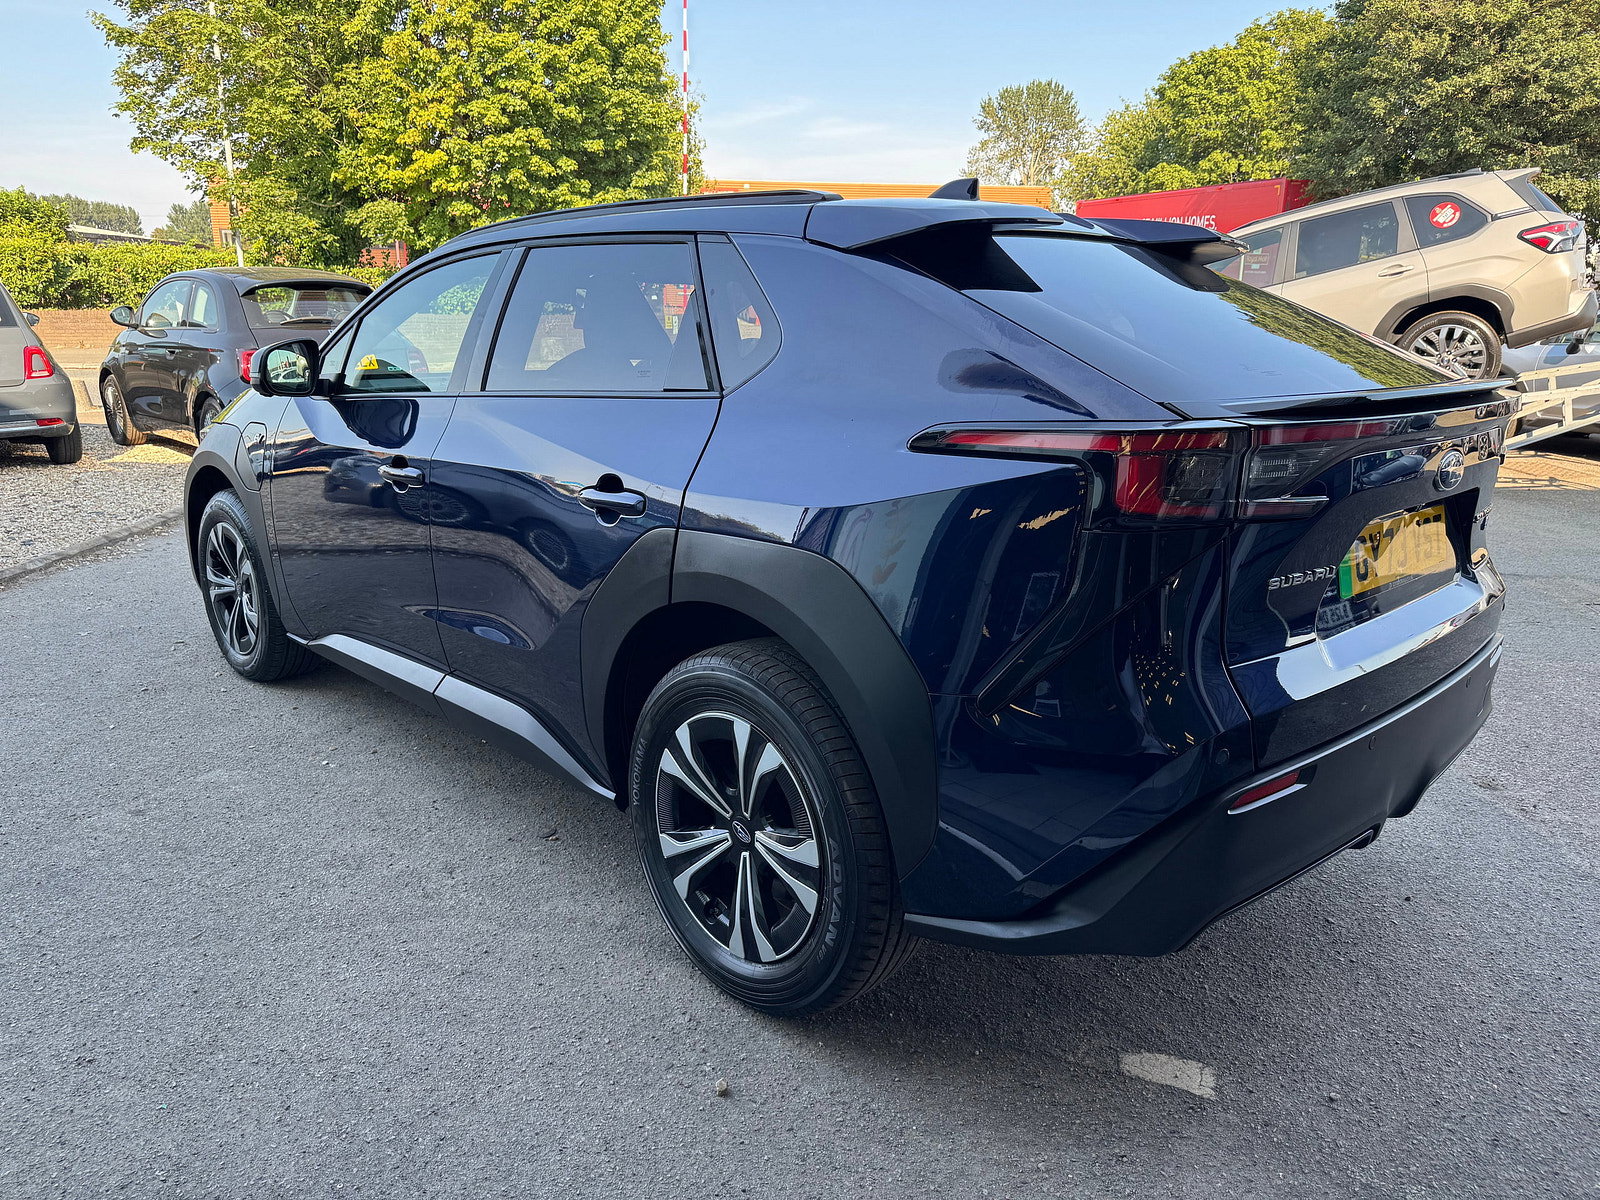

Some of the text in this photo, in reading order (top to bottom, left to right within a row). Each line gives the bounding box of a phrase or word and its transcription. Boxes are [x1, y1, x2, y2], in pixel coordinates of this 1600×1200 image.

[1268, 565, 1336, 591] SUBARU
[632, 738, 648, 806] YOKOHAMA
[824, 837, 843, 947] ADVAN
